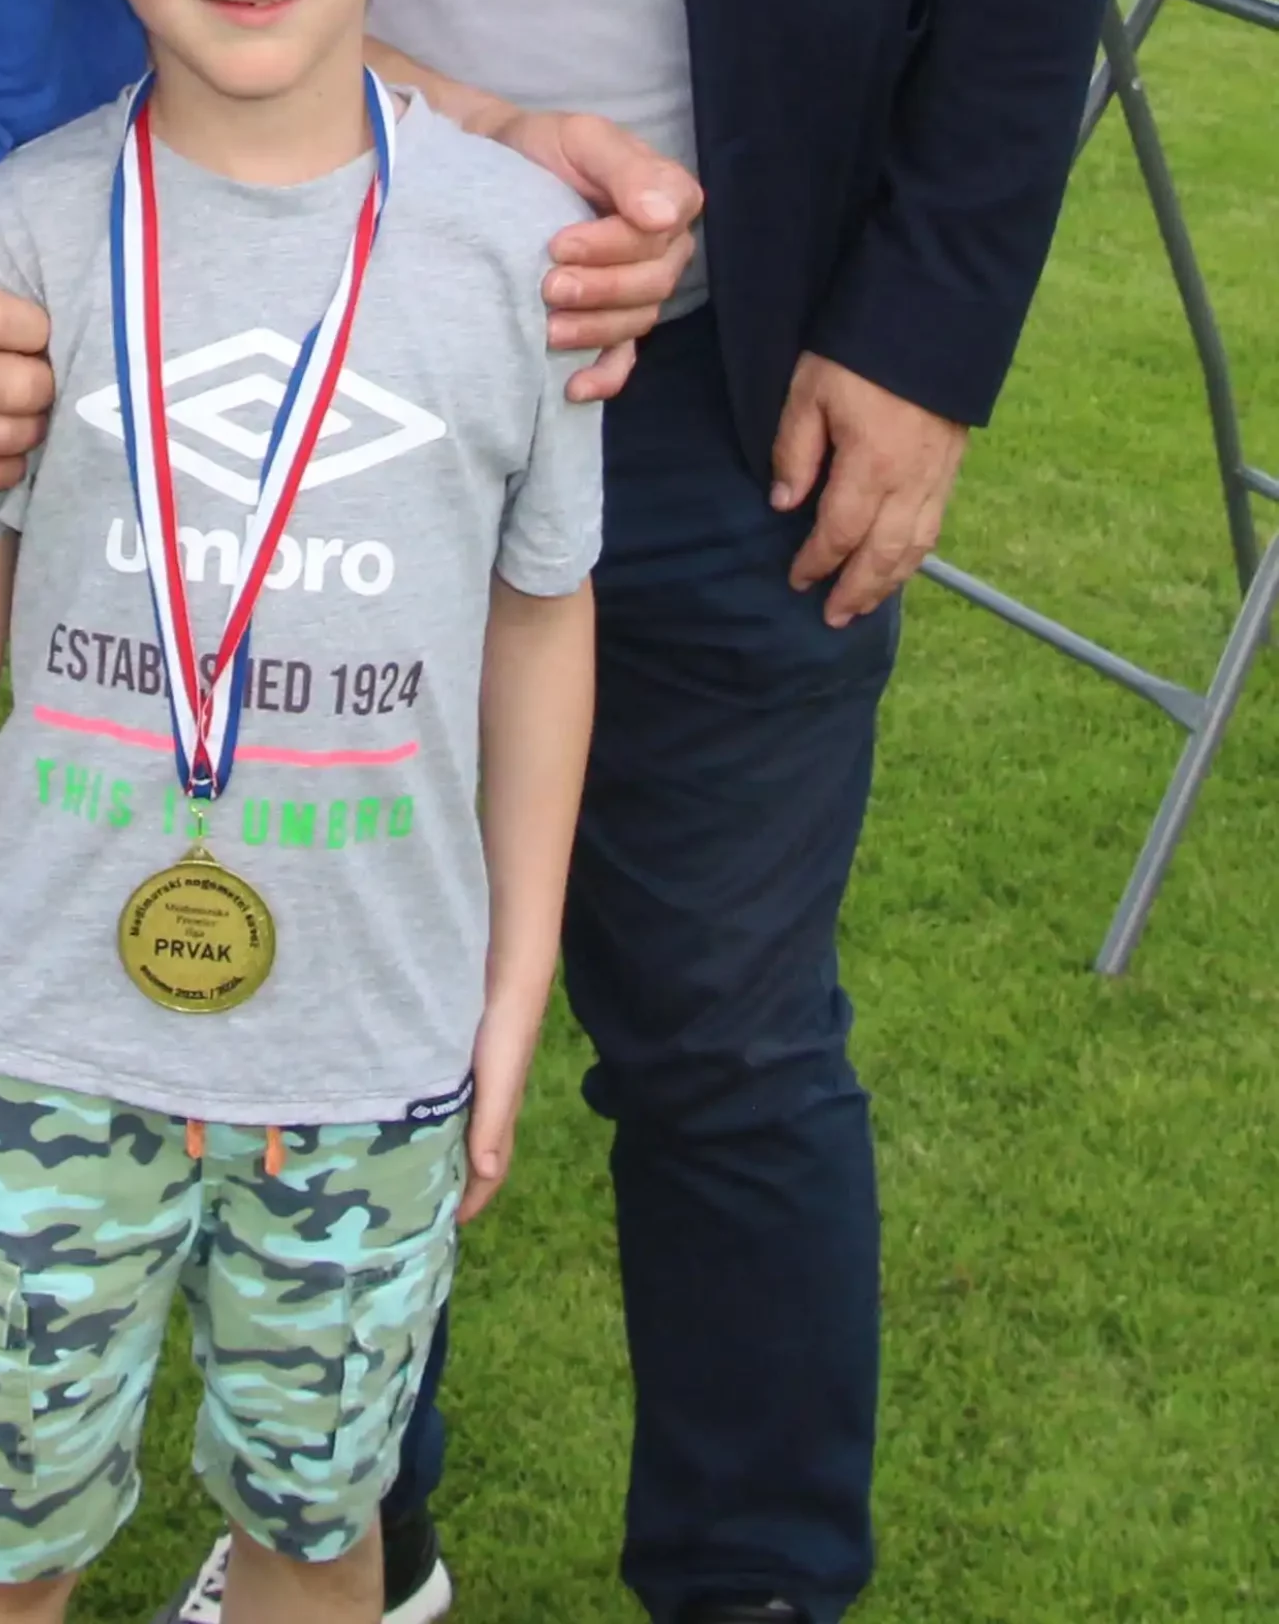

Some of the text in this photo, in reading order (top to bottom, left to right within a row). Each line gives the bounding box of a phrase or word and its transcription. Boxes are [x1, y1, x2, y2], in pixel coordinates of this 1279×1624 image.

[330, 660, 423, 716] 1924
[35, 756, 135, 828] THIS
[242, 795, 414, 850] UMBRO
[153, 938, 232, 964] PRVAK
